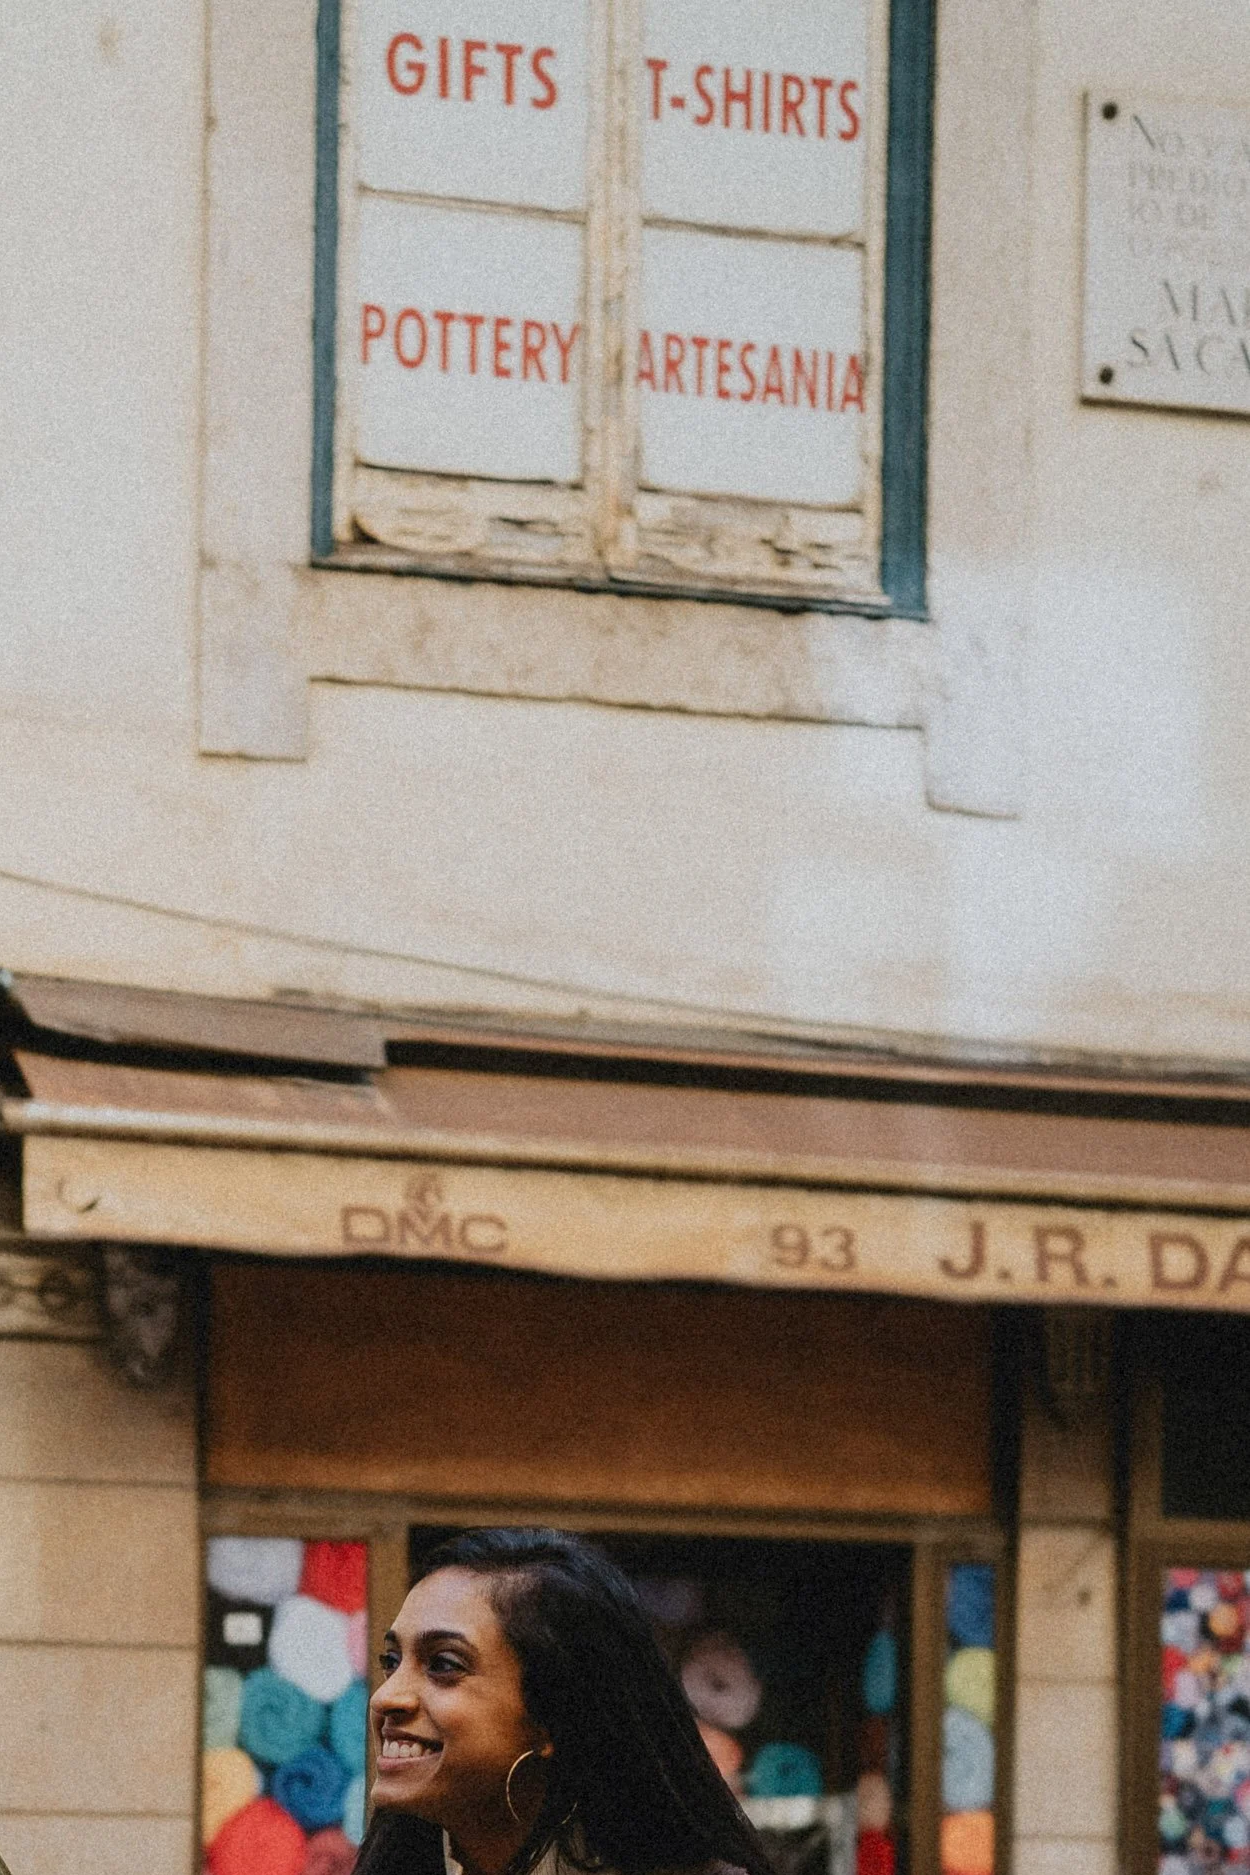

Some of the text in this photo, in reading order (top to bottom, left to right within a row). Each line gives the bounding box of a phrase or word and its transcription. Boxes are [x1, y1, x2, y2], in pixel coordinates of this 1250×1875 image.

[385, 32, 558, 110] GIFTS
[645, 58, 860, 142] T-SHIRTS
[360, 303, 582, 384] POTTERY
[637, 330, 866, 413] ARTESANIA
[341, 1204, 510, 1256] DMC
[769, 1222, 857, 1273] 93
